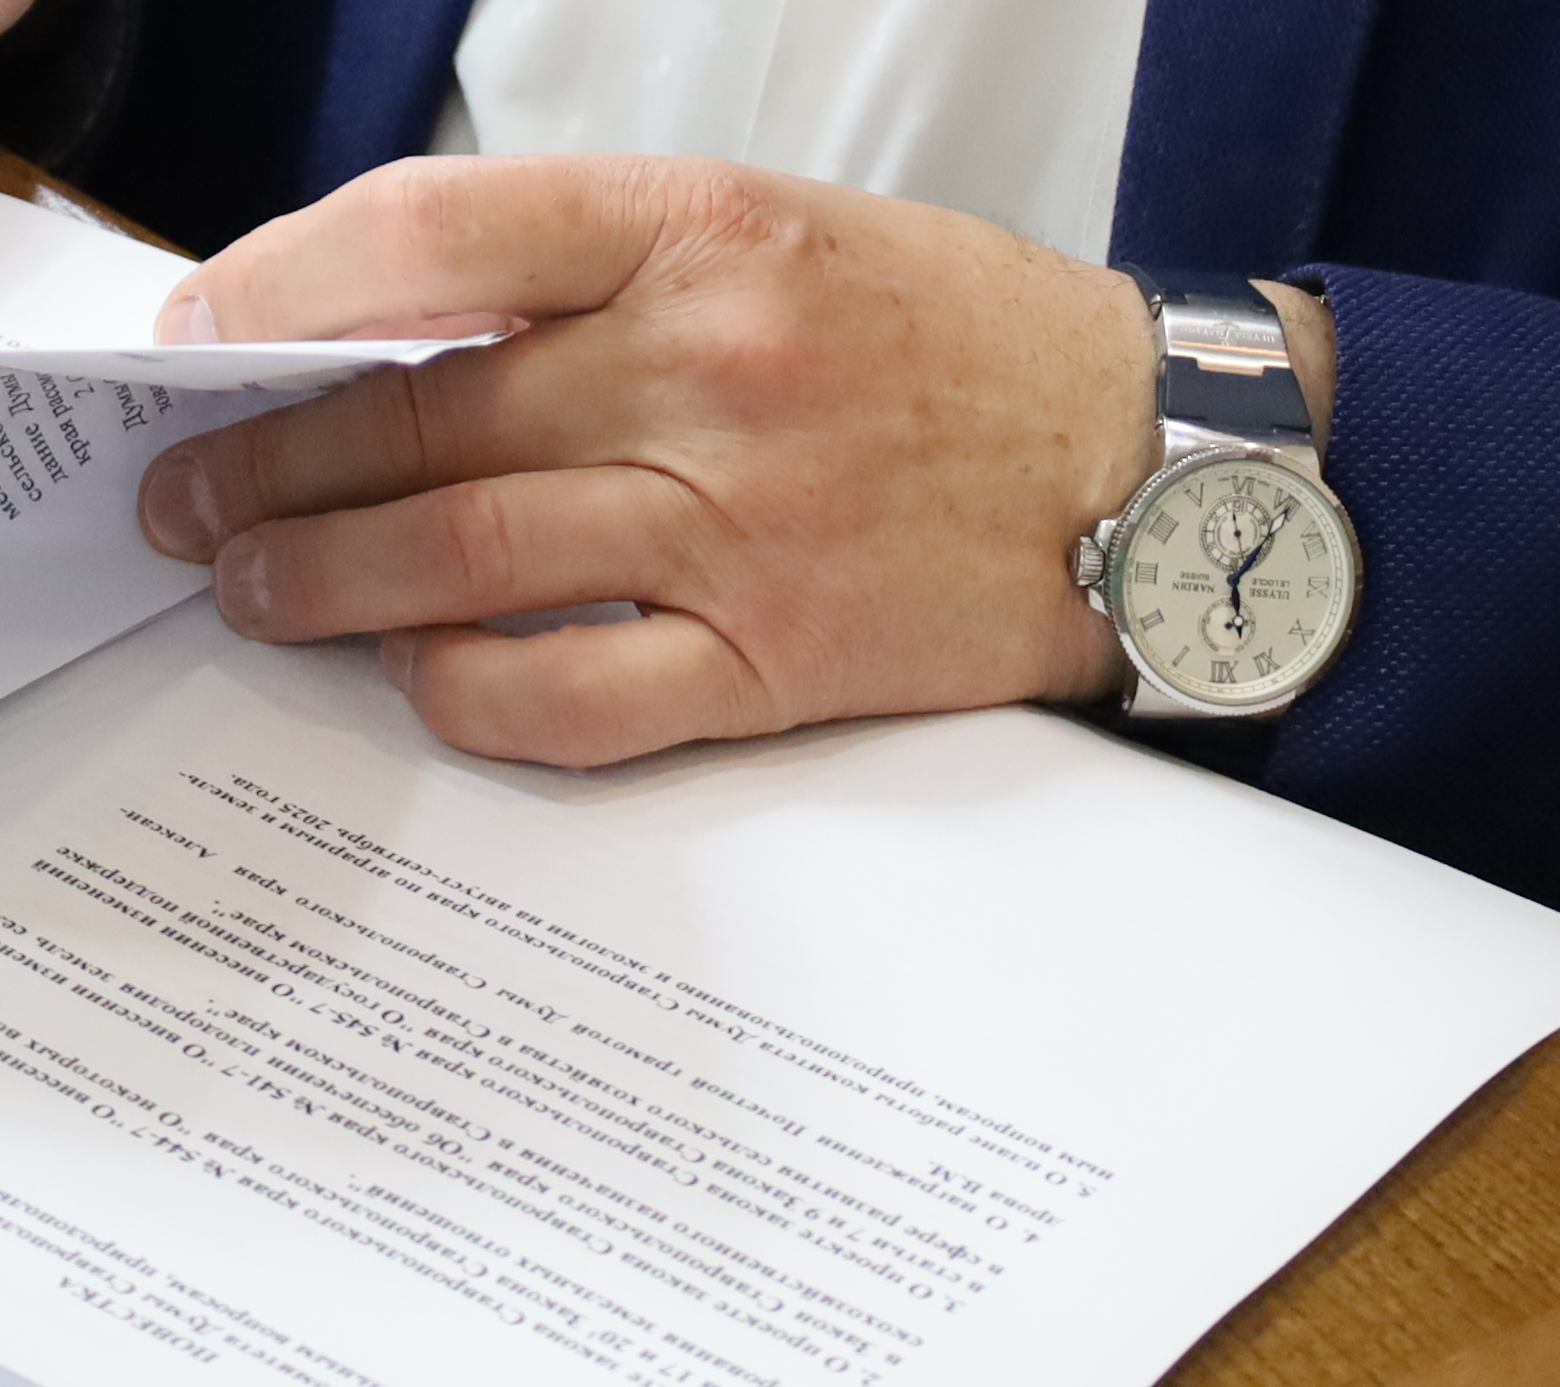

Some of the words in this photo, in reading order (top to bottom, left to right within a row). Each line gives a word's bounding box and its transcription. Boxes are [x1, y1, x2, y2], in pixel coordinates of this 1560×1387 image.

[113, 382, 149, 431] Думы
[24, 422, 69, 483] дание
[58, 417, 92, 466] края
[1172, 580, 1215, 594] NARDIN
[1249, 587, 1291, 601] ULYSSE
[178, 771, 258, 814] земель-
[230, 773, 281, 804] года.
[119, 807, 217, 858] Алексан-
[259, 812, 277, 824] и
[277, 802, 332, 830] 2025
[278, 821, 391, 878] аграрным
[336, 827, 512, 911] август-сентябрь
[30, 858, 158, 927] изменений
[55, 846, 180, 913] поддержке
[232, 865, 287, 896] края
[393, 876, 423, 893] по
[425, 890, 481, 919] края
[158, 925, 270, 984] внесении
[177, 910, 381, 1011] государственной
[294, 896, 487, 989] Ставропольского
[483, 917, 680, 1011] Ставропольского
[545, 923, 649, 974] экологии
[307, 1003, 379, 1037] 545-7
[494, 987, 568, 1024] Думы
[684, 1007, 758, 1044] Думы
[380, 1033, 413, 1053] №
[422, 1026, 485, 1059] края
[569, 1022, 683, 1077] грамотой
[674, 981, 926, 1097] природопользованию
[414, 1048, 477, 1080] края
[758, 1040, 870, 1095] комитета
[487, 1055, 707, 1164] Ставропольского
[688, 1076, 807, 1137] Почетной
[873, 1092, 967, 1136] работы
[933, 1094, 1053, 1154] вопросам,
[479, 1077, 700, 1187] Ставропольского
[967, 1134, 1042, 1171] плане
[711, 1158, 801, 1209] Закона
[815, 1134, 978, 1213] награждении
[927, 1160, 984, 1195] В.М.
[1056, 1150, 1114, 1181] ным
[704, 1182, 793, 1230] закона
[988, 1189, 1063, 1226] дрова
[797, 1228, 906, 1284] проекте
[869, 1236, 963, 1283] статьи
[58, 1275, 219, 1364] ПОВЕСТКА
